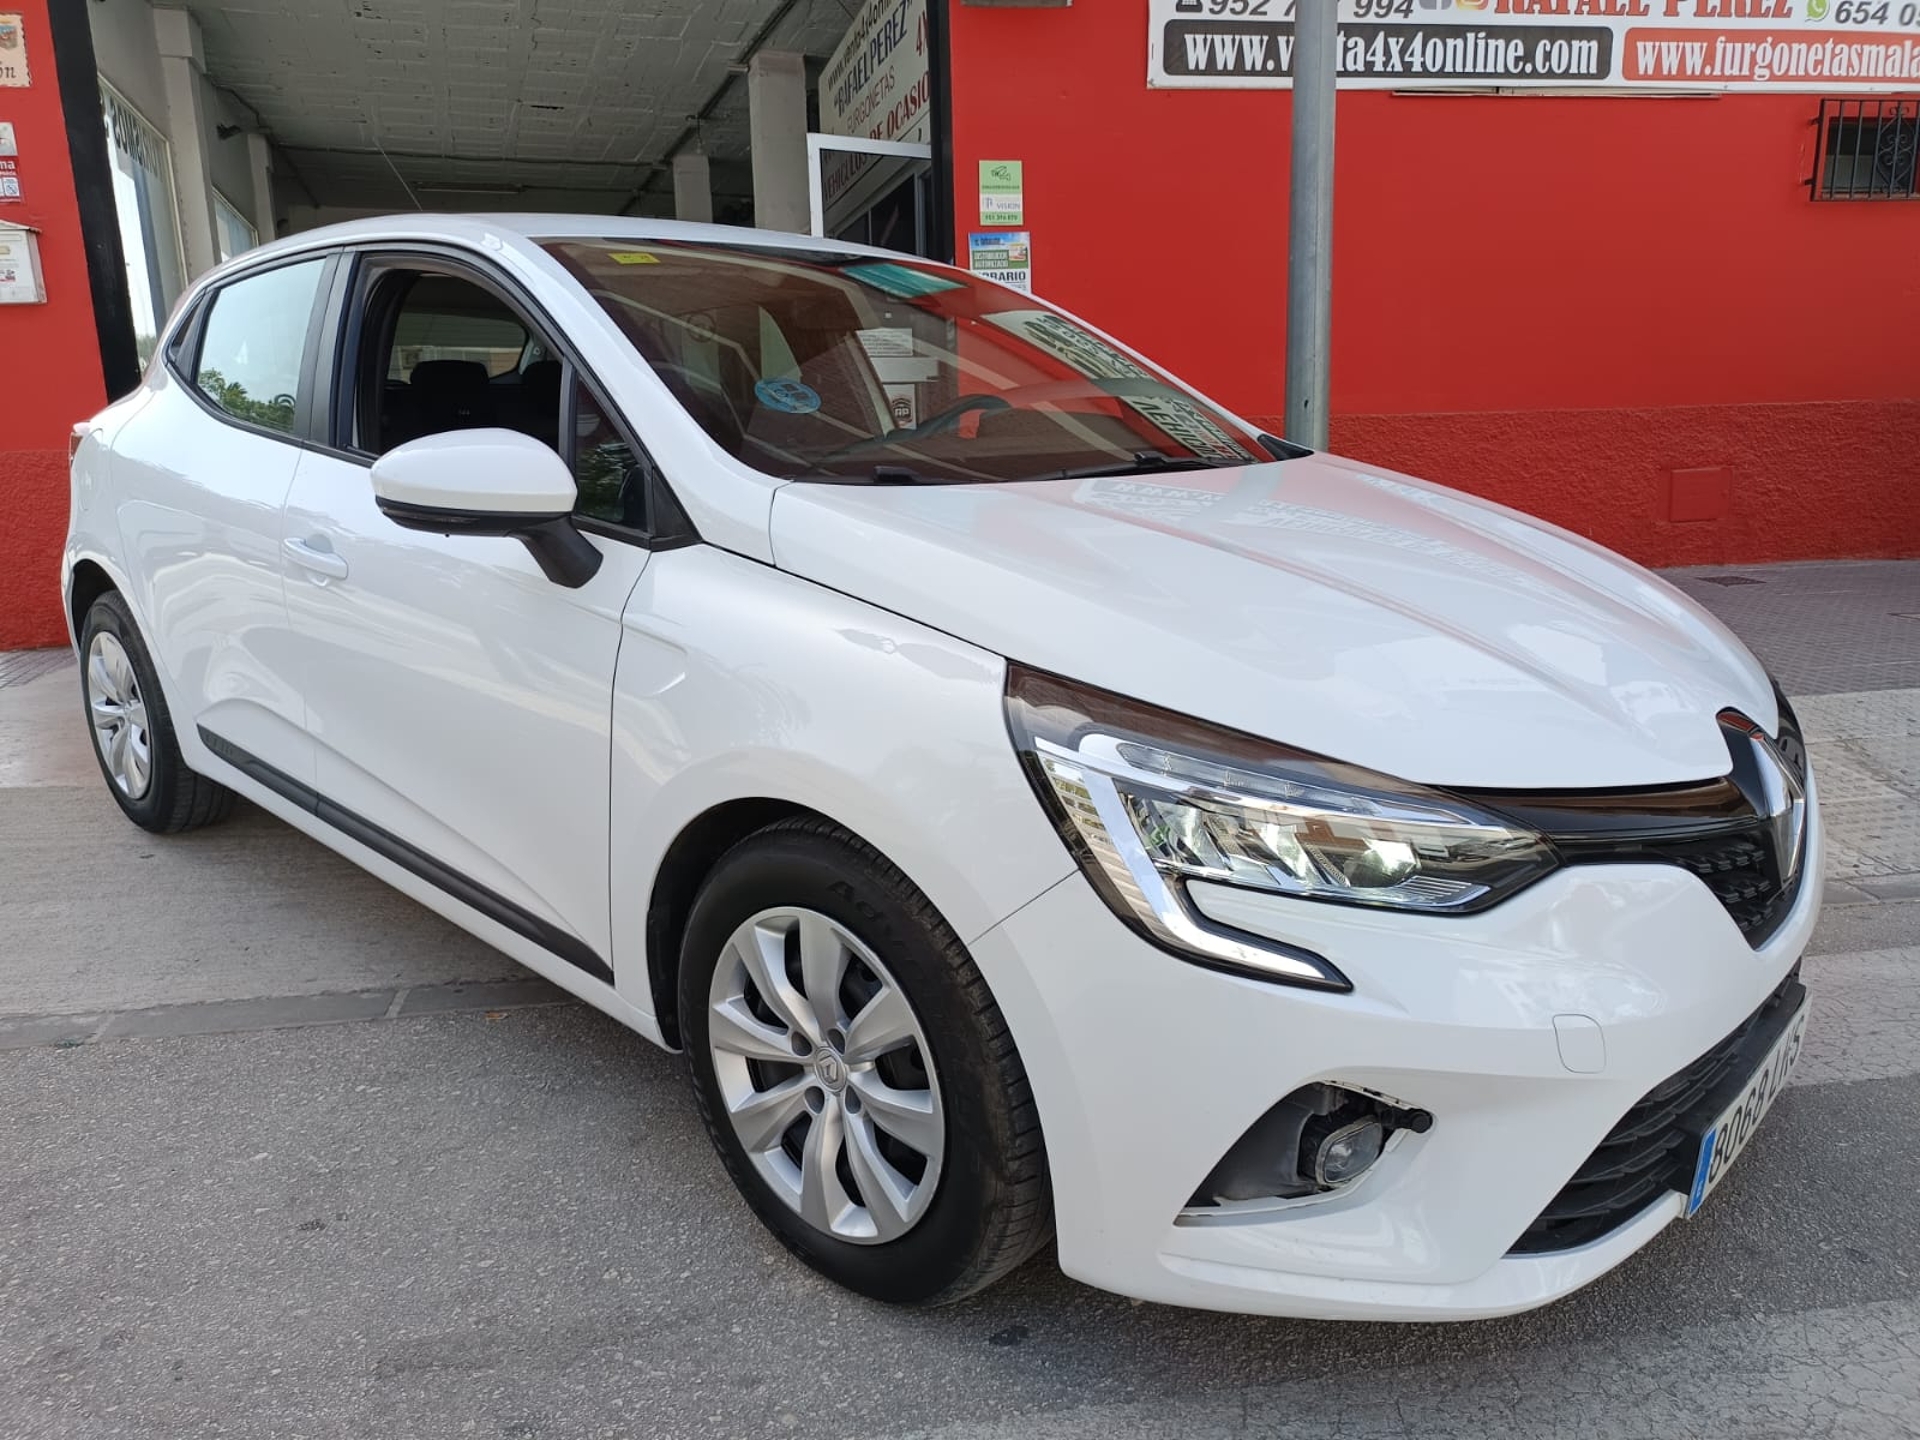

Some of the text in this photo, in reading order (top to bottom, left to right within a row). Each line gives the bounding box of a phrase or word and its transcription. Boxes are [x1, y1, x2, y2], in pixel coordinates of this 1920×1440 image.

[1834, 0, 1889, 25] 654
[1184, 31, 1599, 76] www.vta4x4online.com
[1708, 1069, 1769, 1184] 8068
